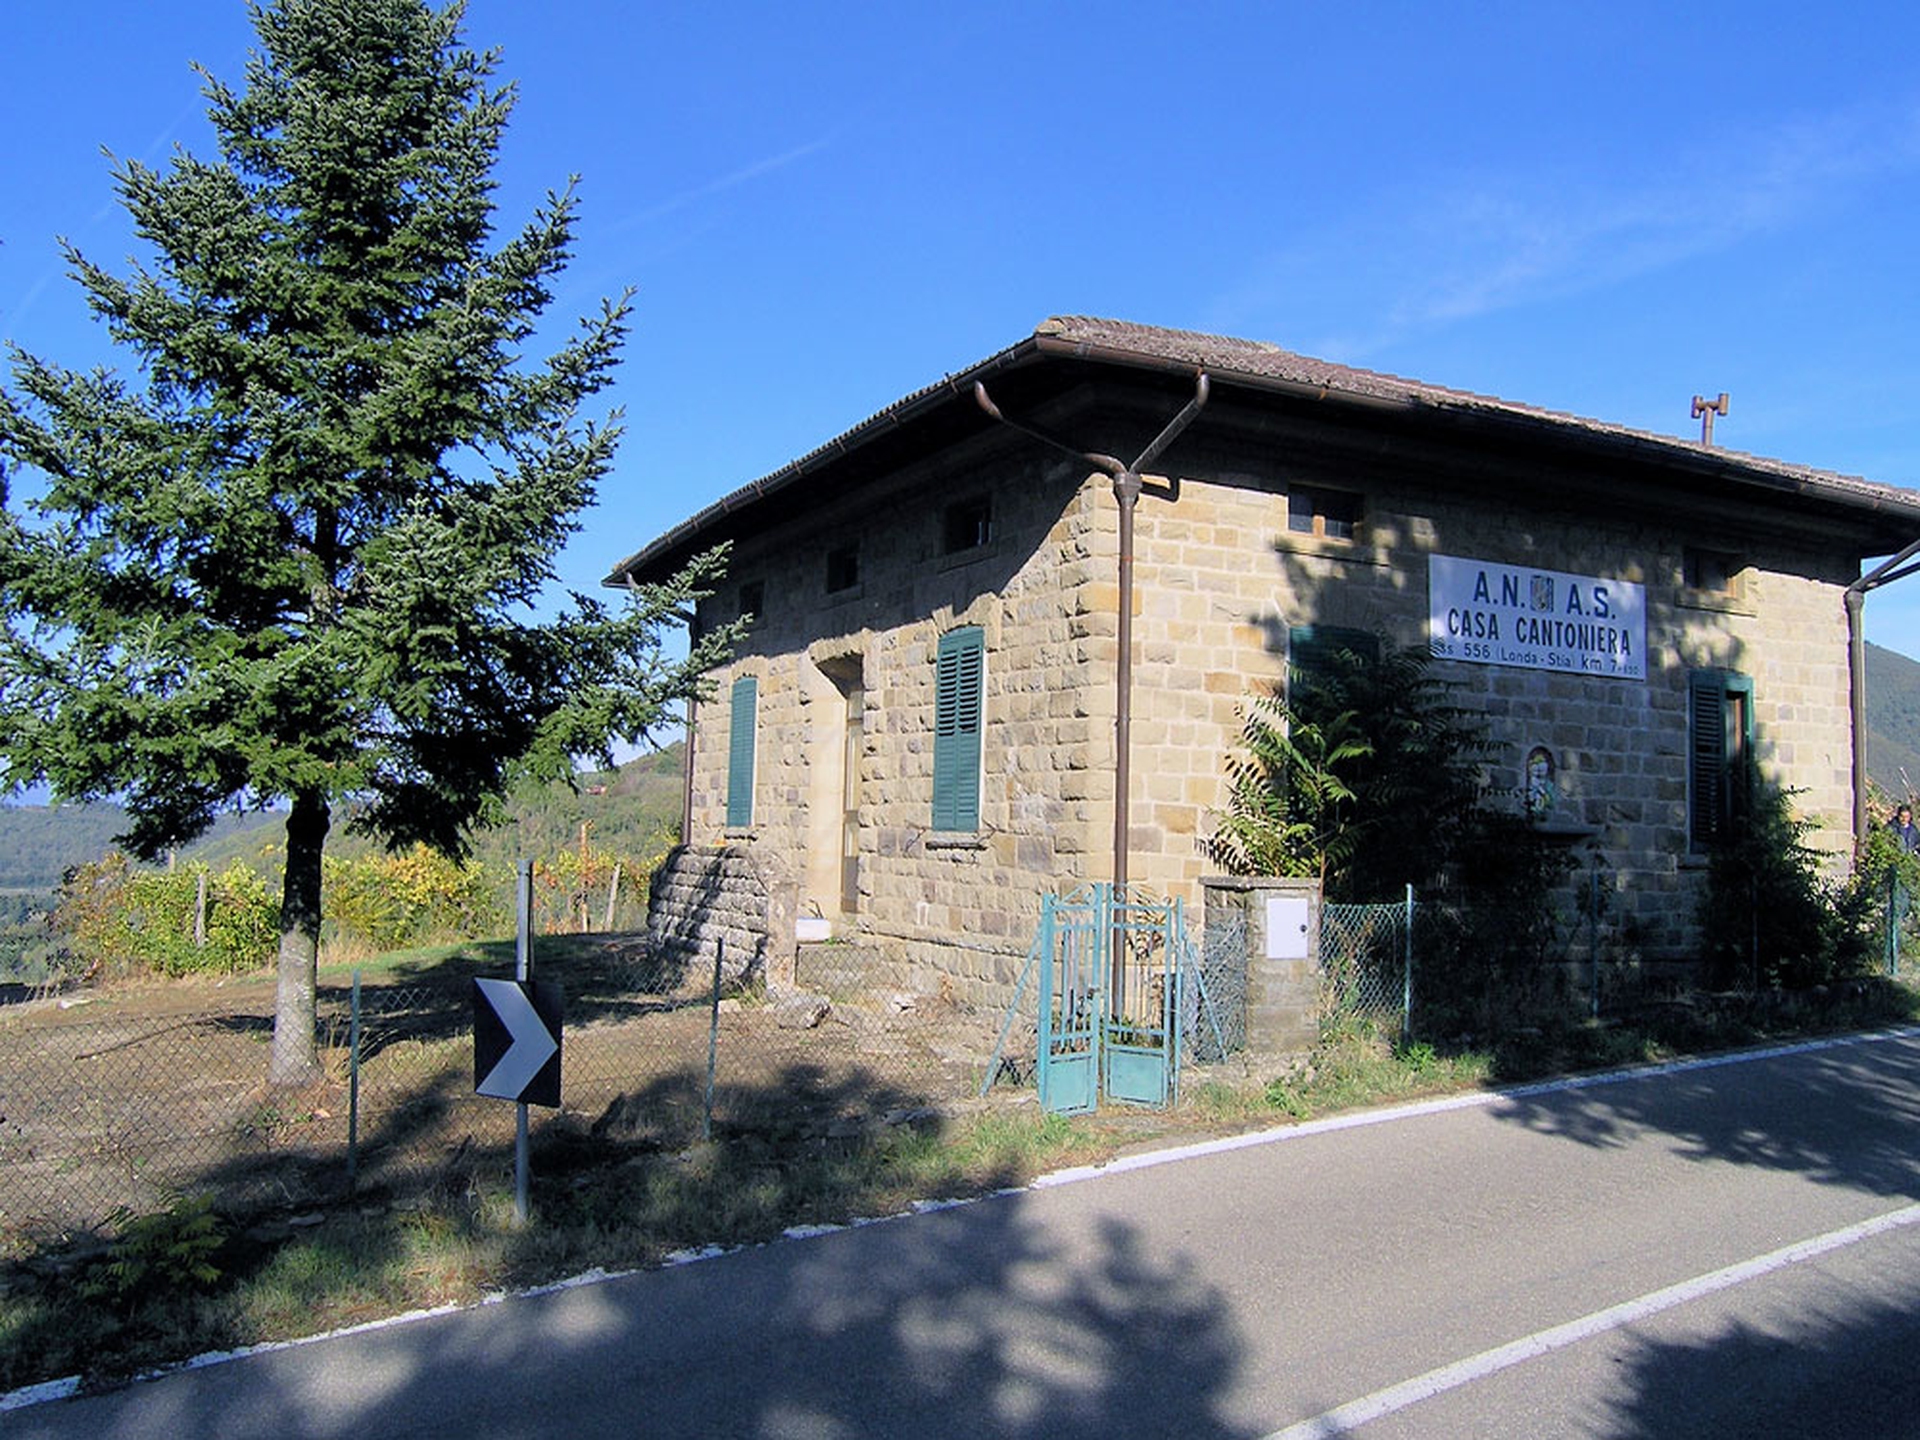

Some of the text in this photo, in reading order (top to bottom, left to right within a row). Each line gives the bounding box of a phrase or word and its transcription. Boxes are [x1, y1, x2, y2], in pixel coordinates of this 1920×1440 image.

[1473, 571, 1616, 620] A.N. A.S.
[1448, 608, 1631, 656] CASA CANTONIERA
[1464, 642, 1491, 659] 556
[1582, 654, 1602, 671] km
